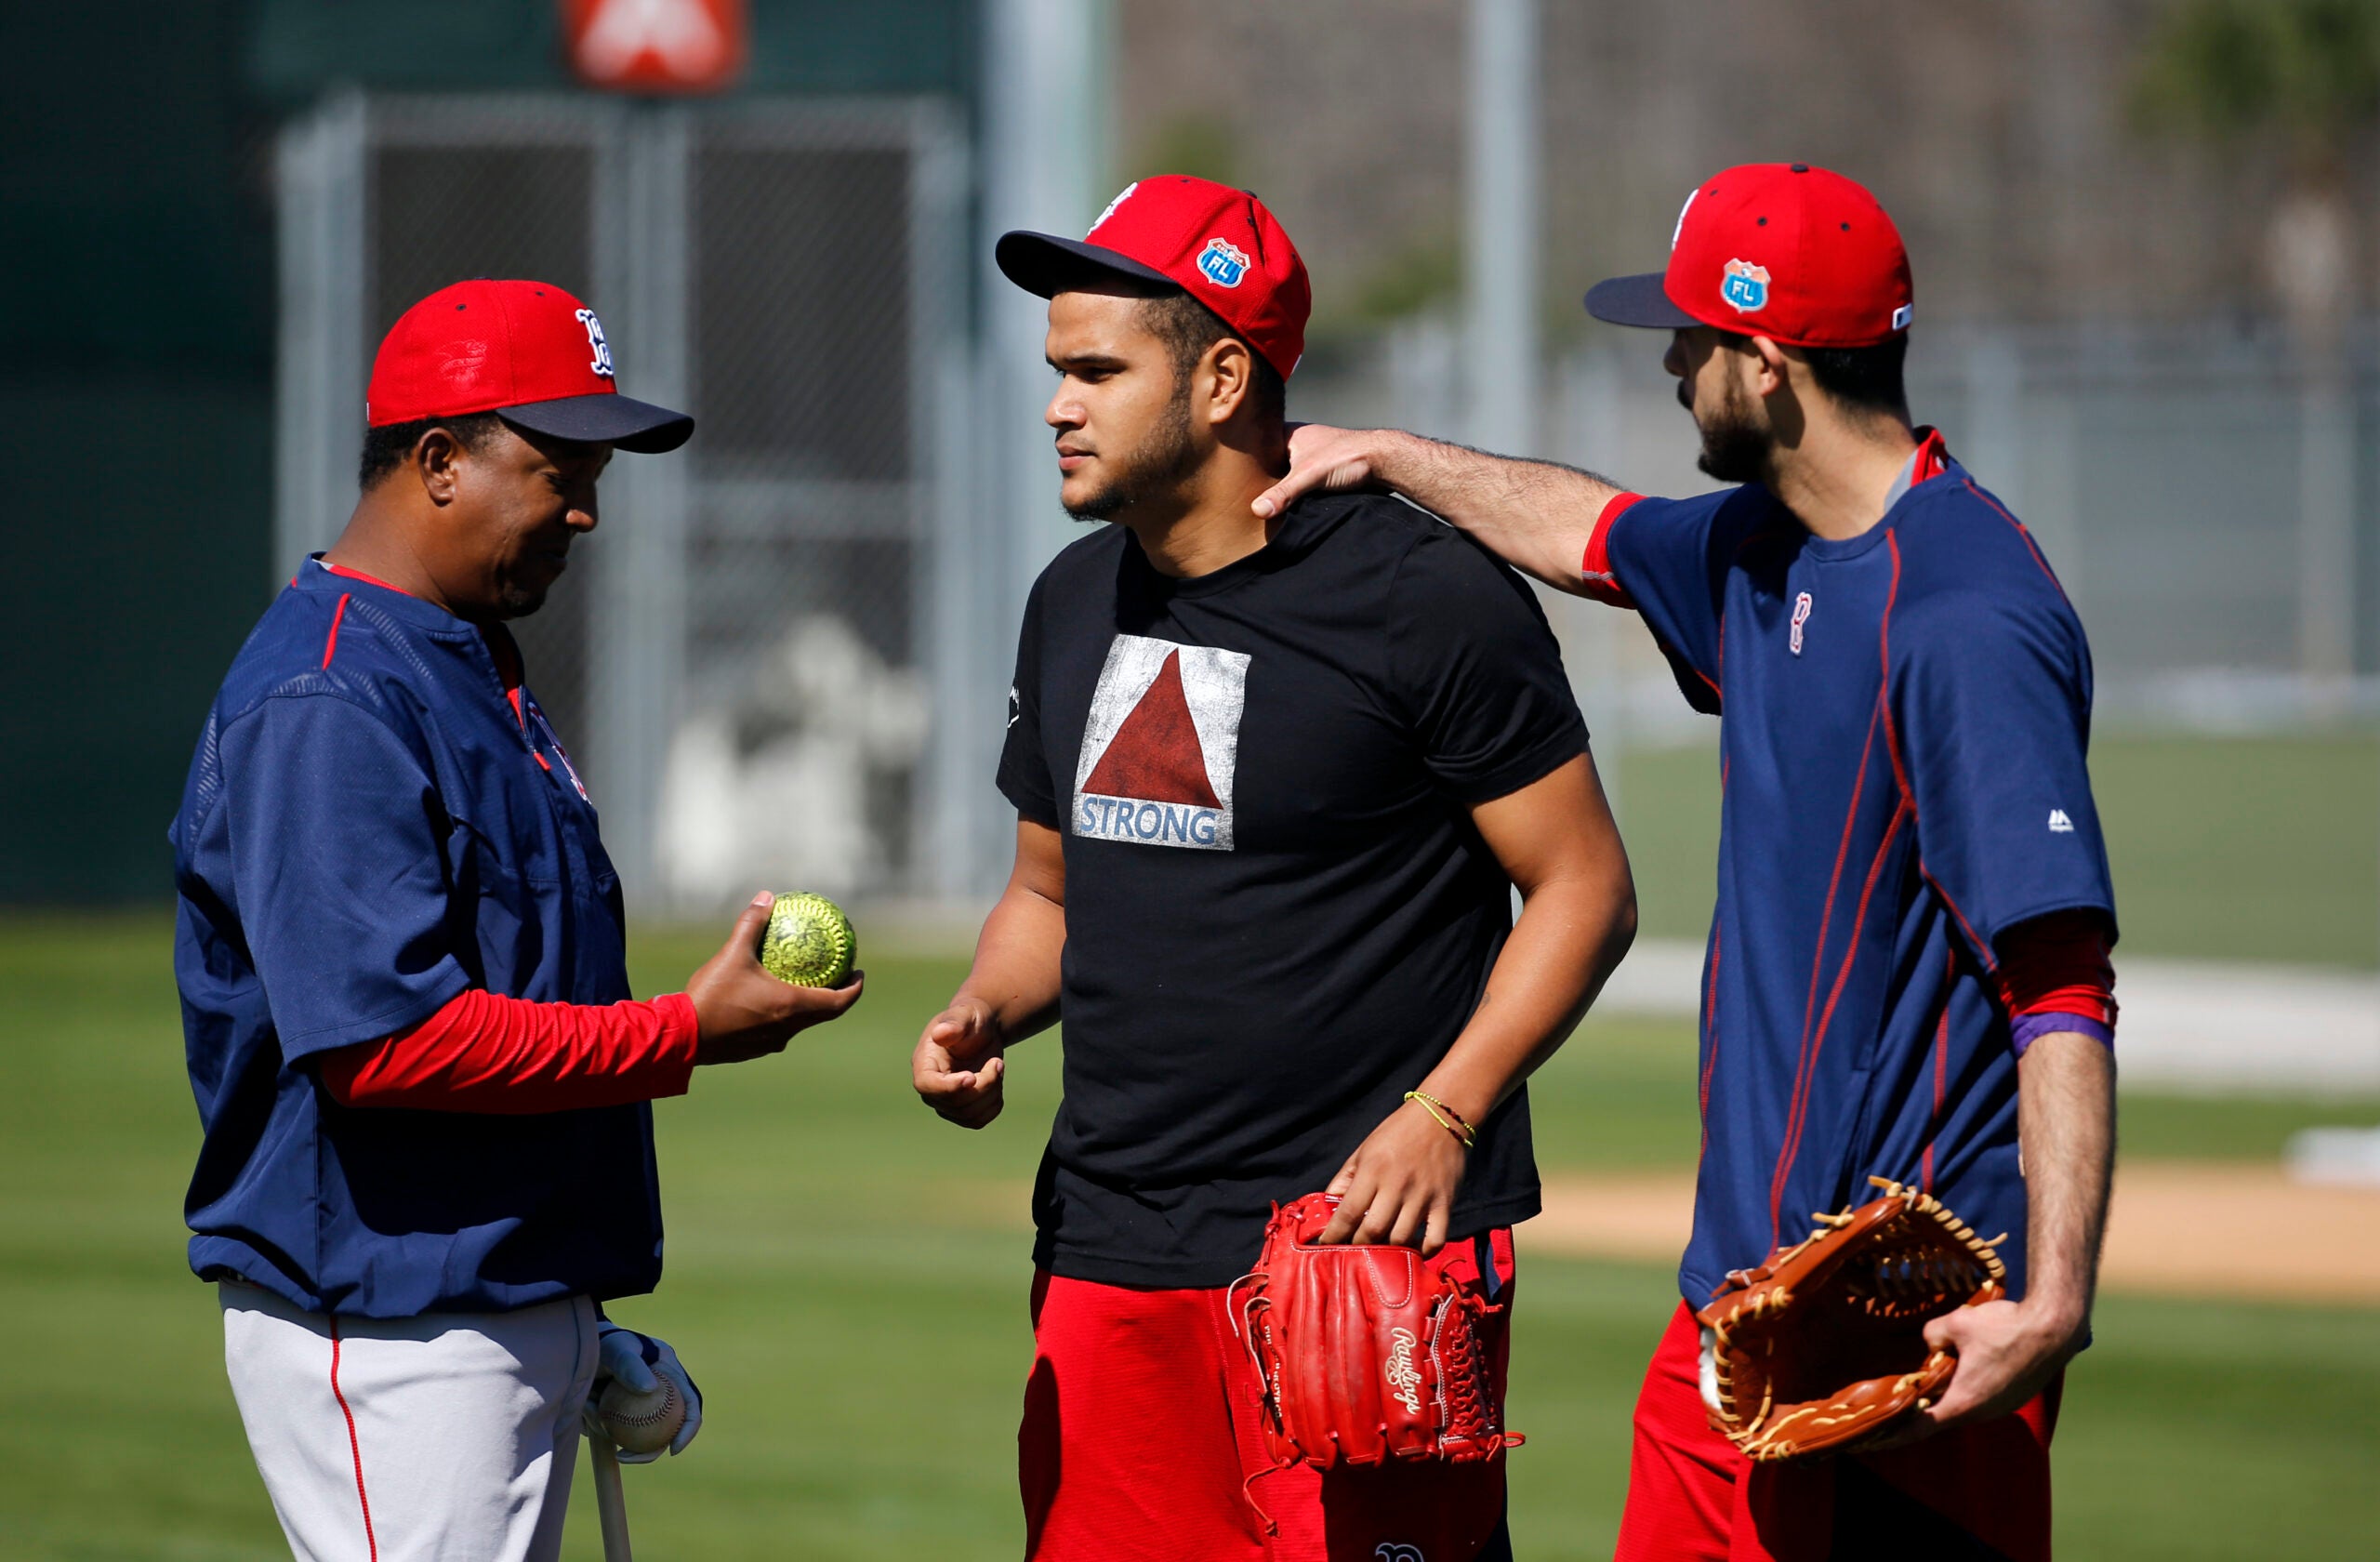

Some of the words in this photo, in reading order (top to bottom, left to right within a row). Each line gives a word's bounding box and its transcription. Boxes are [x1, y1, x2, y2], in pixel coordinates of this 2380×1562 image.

[1207, 255, 1229, 279] FL
[1732, 281, 1754, 302] FL
[1080, 797, 1217, 845] STRONG
[1391, 1327, 1423, 1415] Rawlings
